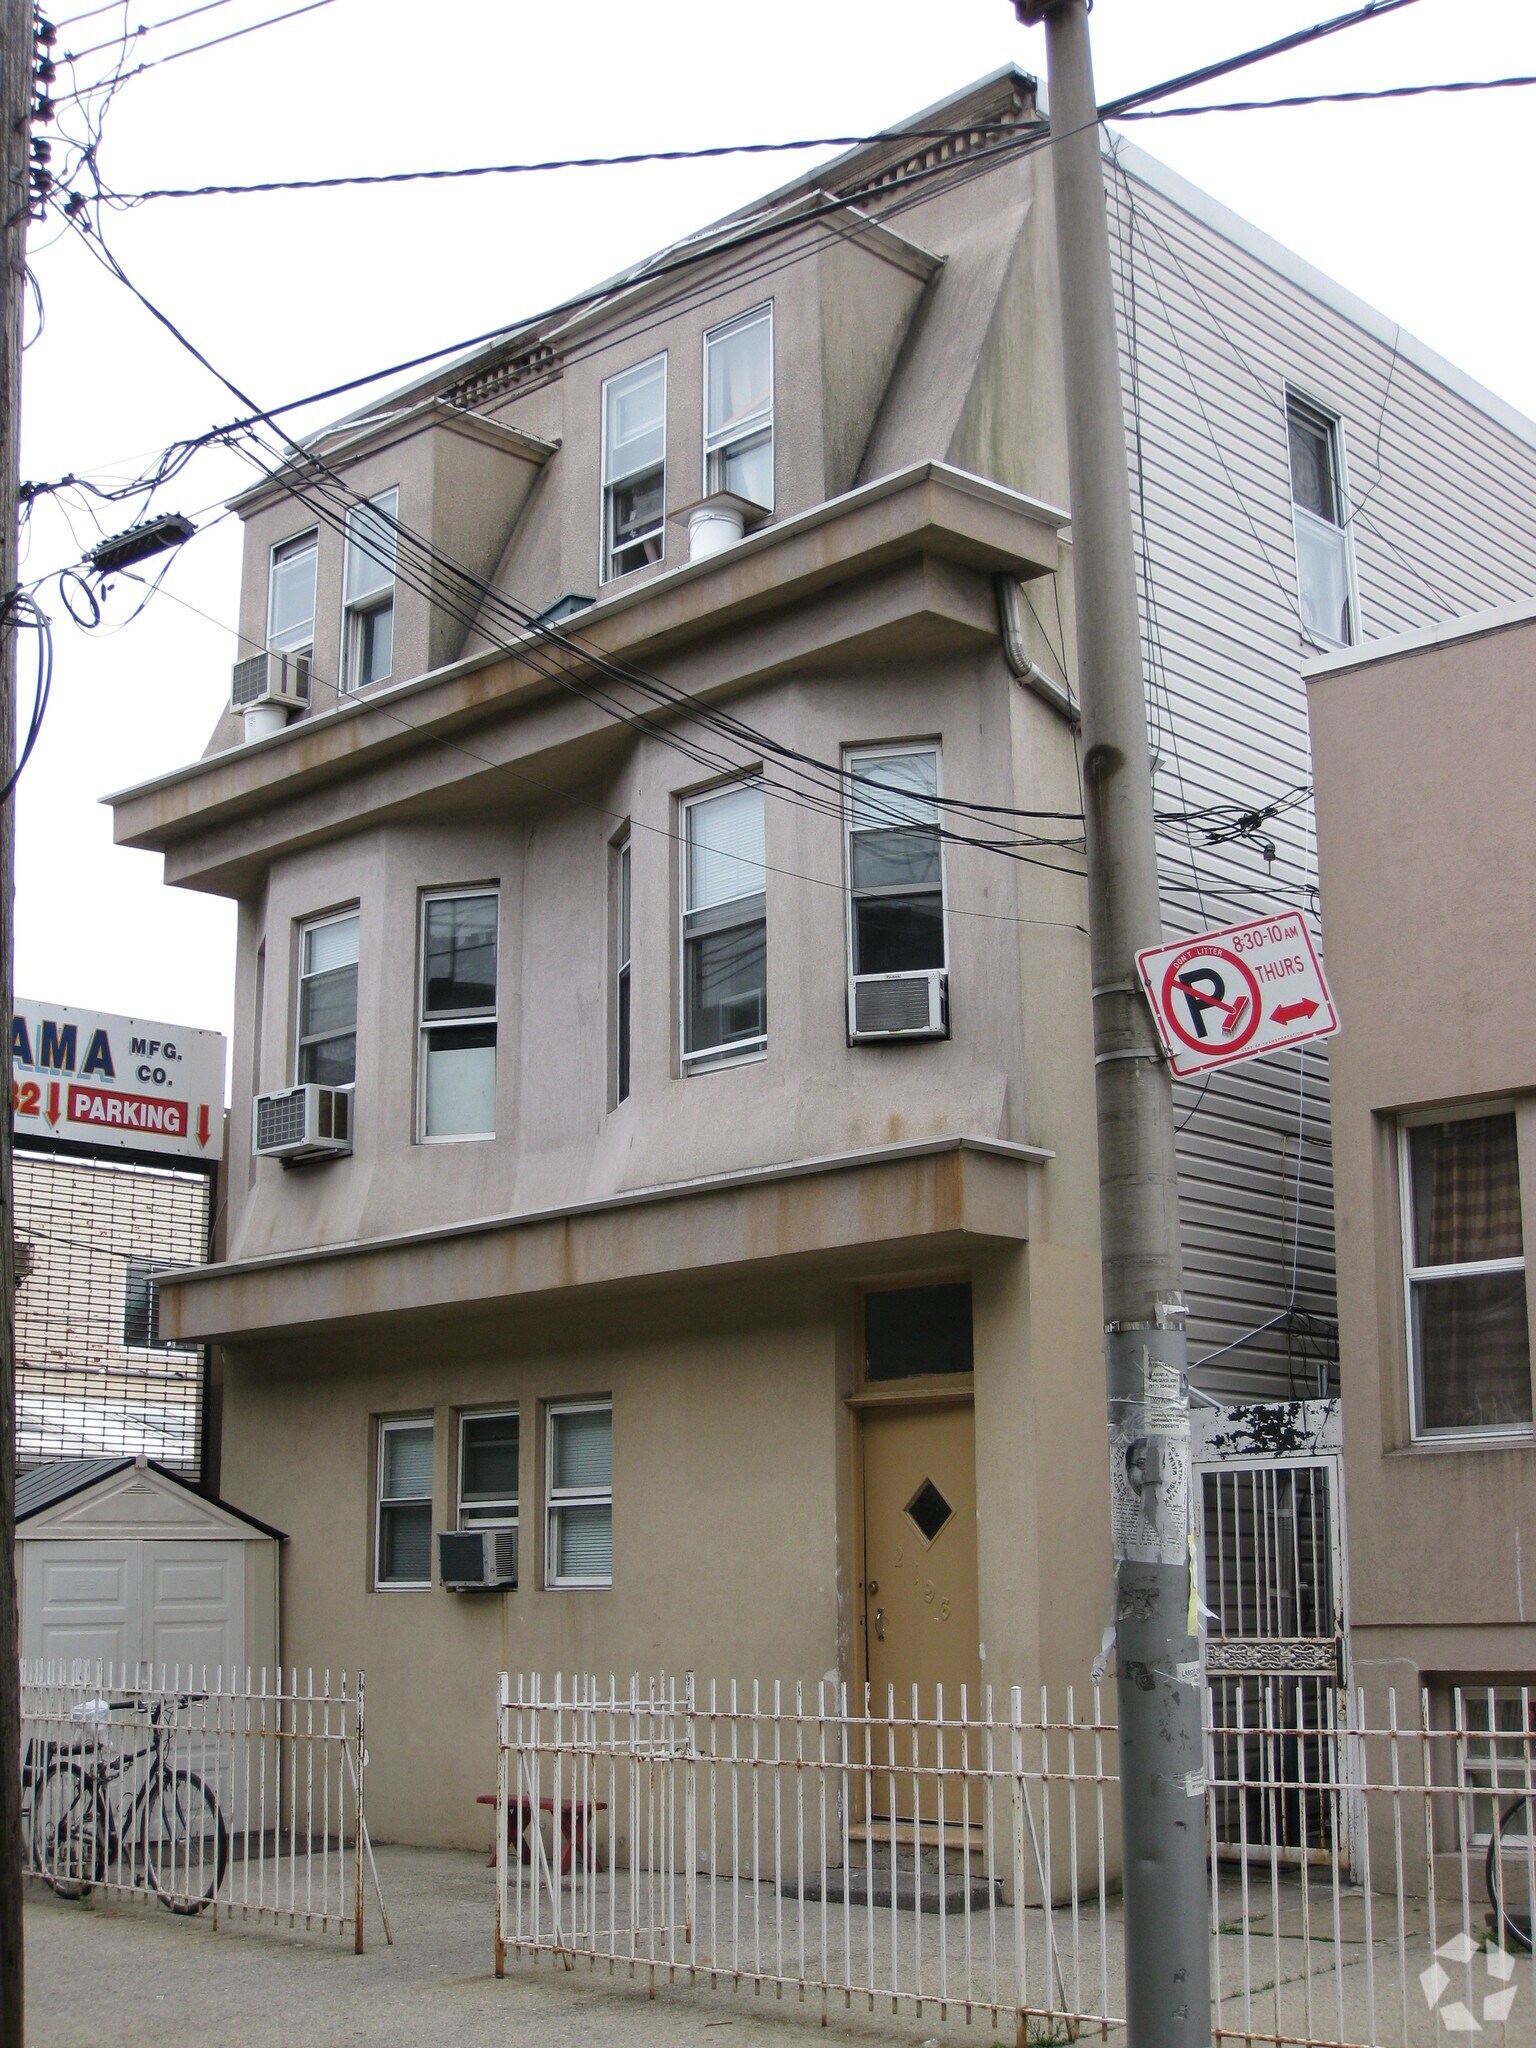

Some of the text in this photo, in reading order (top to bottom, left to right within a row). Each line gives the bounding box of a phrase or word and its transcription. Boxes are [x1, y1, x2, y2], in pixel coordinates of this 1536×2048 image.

[1232, 925, 1299, 953] 8:30-10 AM
[1173, 947, 1223, 969] DON'T LITTER
[1255, 955, 1305, 984] THURS
[131, 1037, 183, 1061] MFG.
[137, 1065, 173, 1086] CO.
[74, 1093, 181, 1132] PARKING
